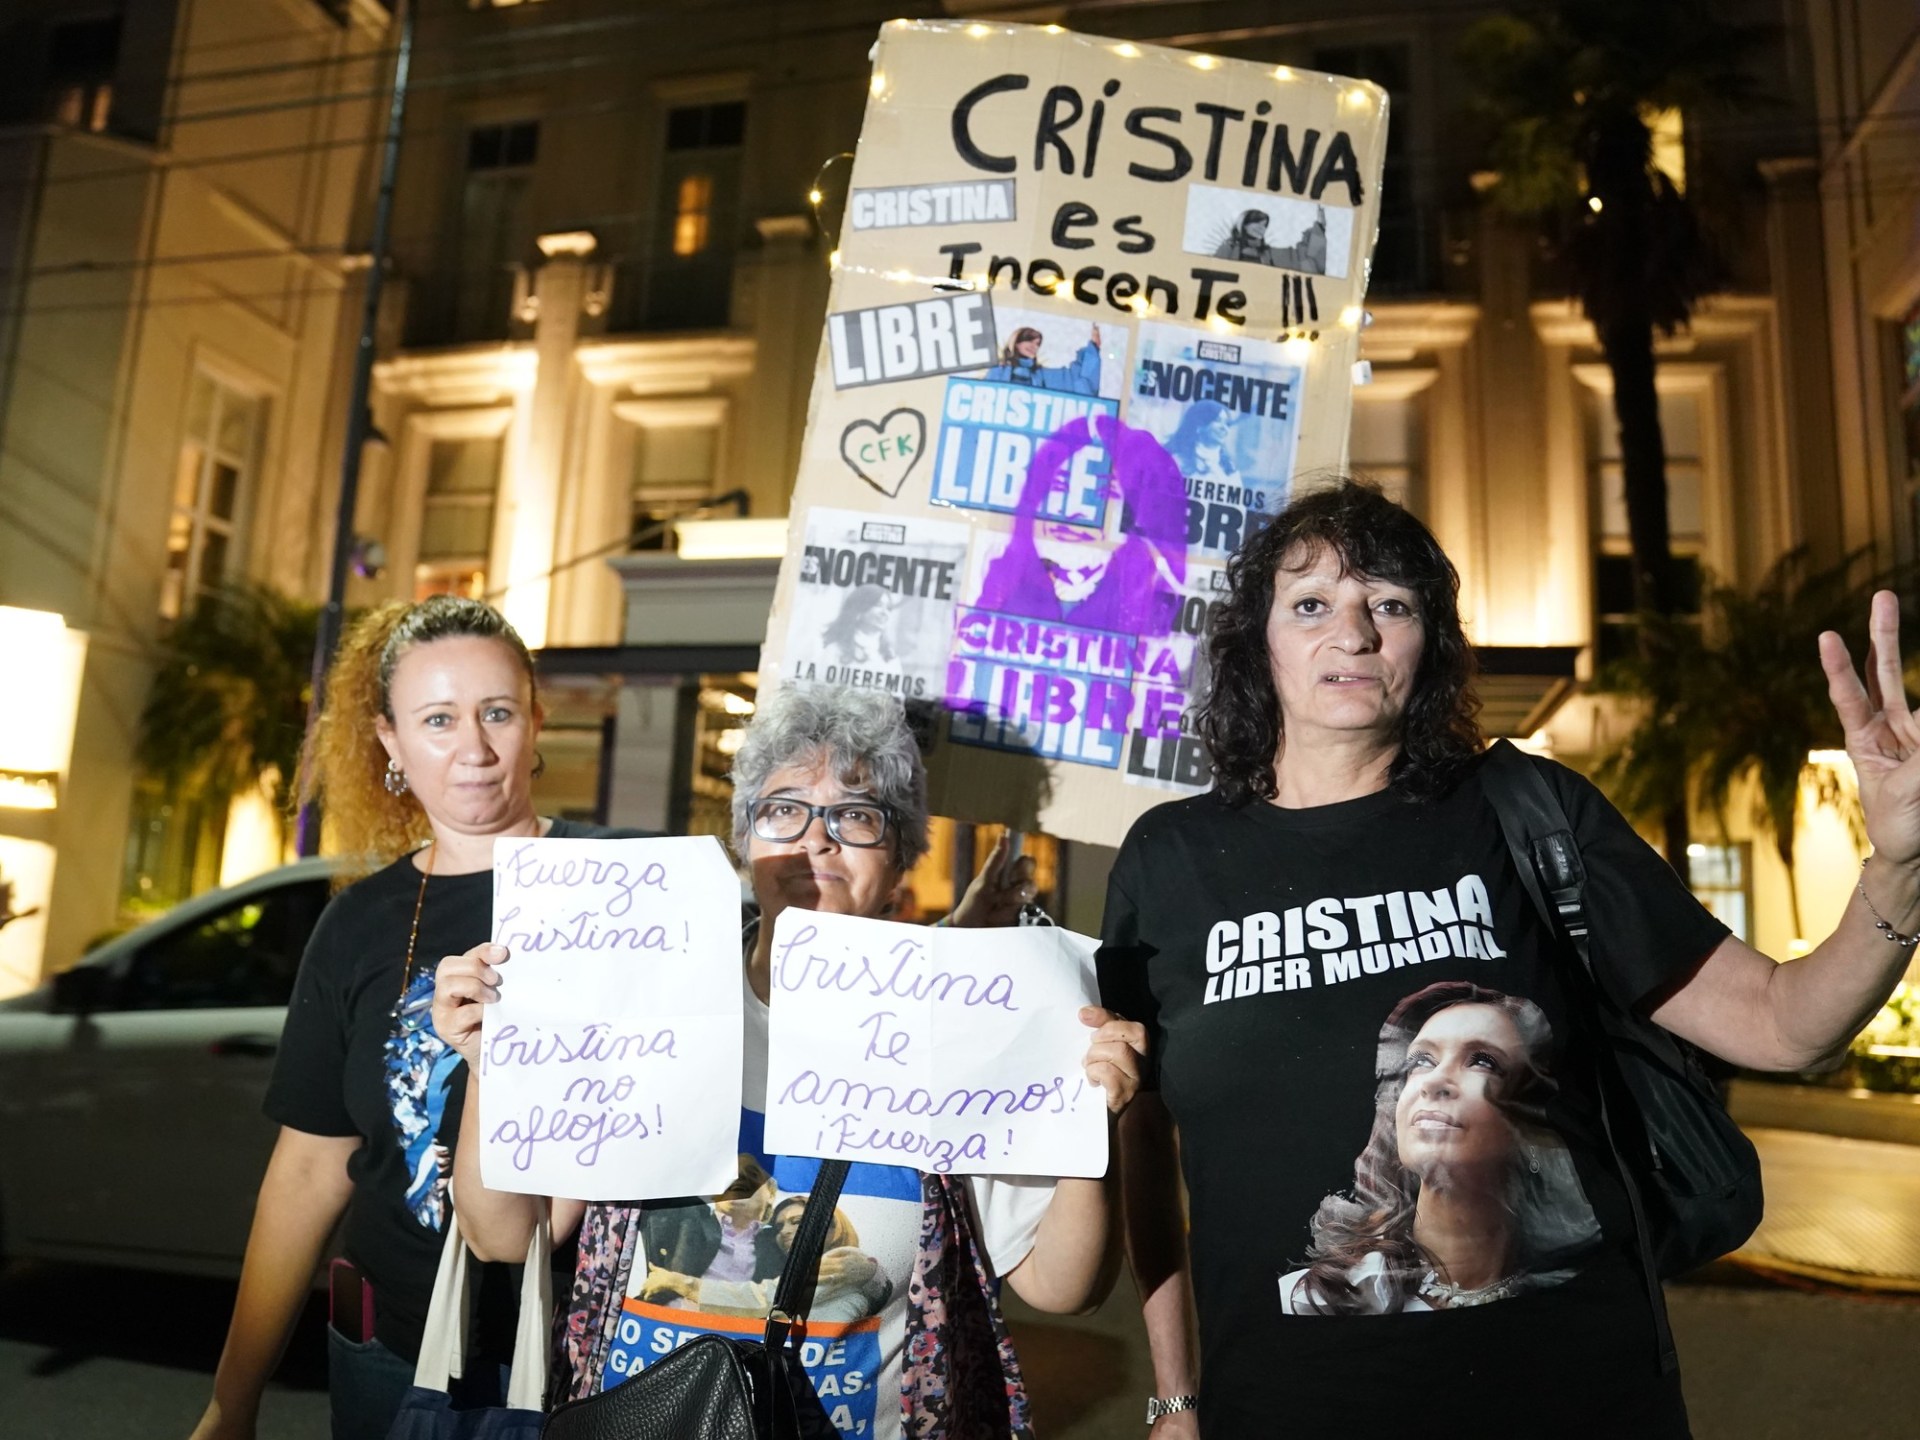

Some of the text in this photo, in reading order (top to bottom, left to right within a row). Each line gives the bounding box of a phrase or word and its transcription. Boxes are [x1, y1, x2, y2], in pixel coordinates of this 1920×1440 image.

[852, 184, 1010, 229] CRISTINA
[829, 293, 991, 386] LIBRE
[860, 434, 914, 463] CFK
[795, 660, 926, 697] LA QUEREMOS
[1205, 874, 1495, 974] CRISTINA
[1203, 924, 1508, 1005] LIDER MUNDIAL
